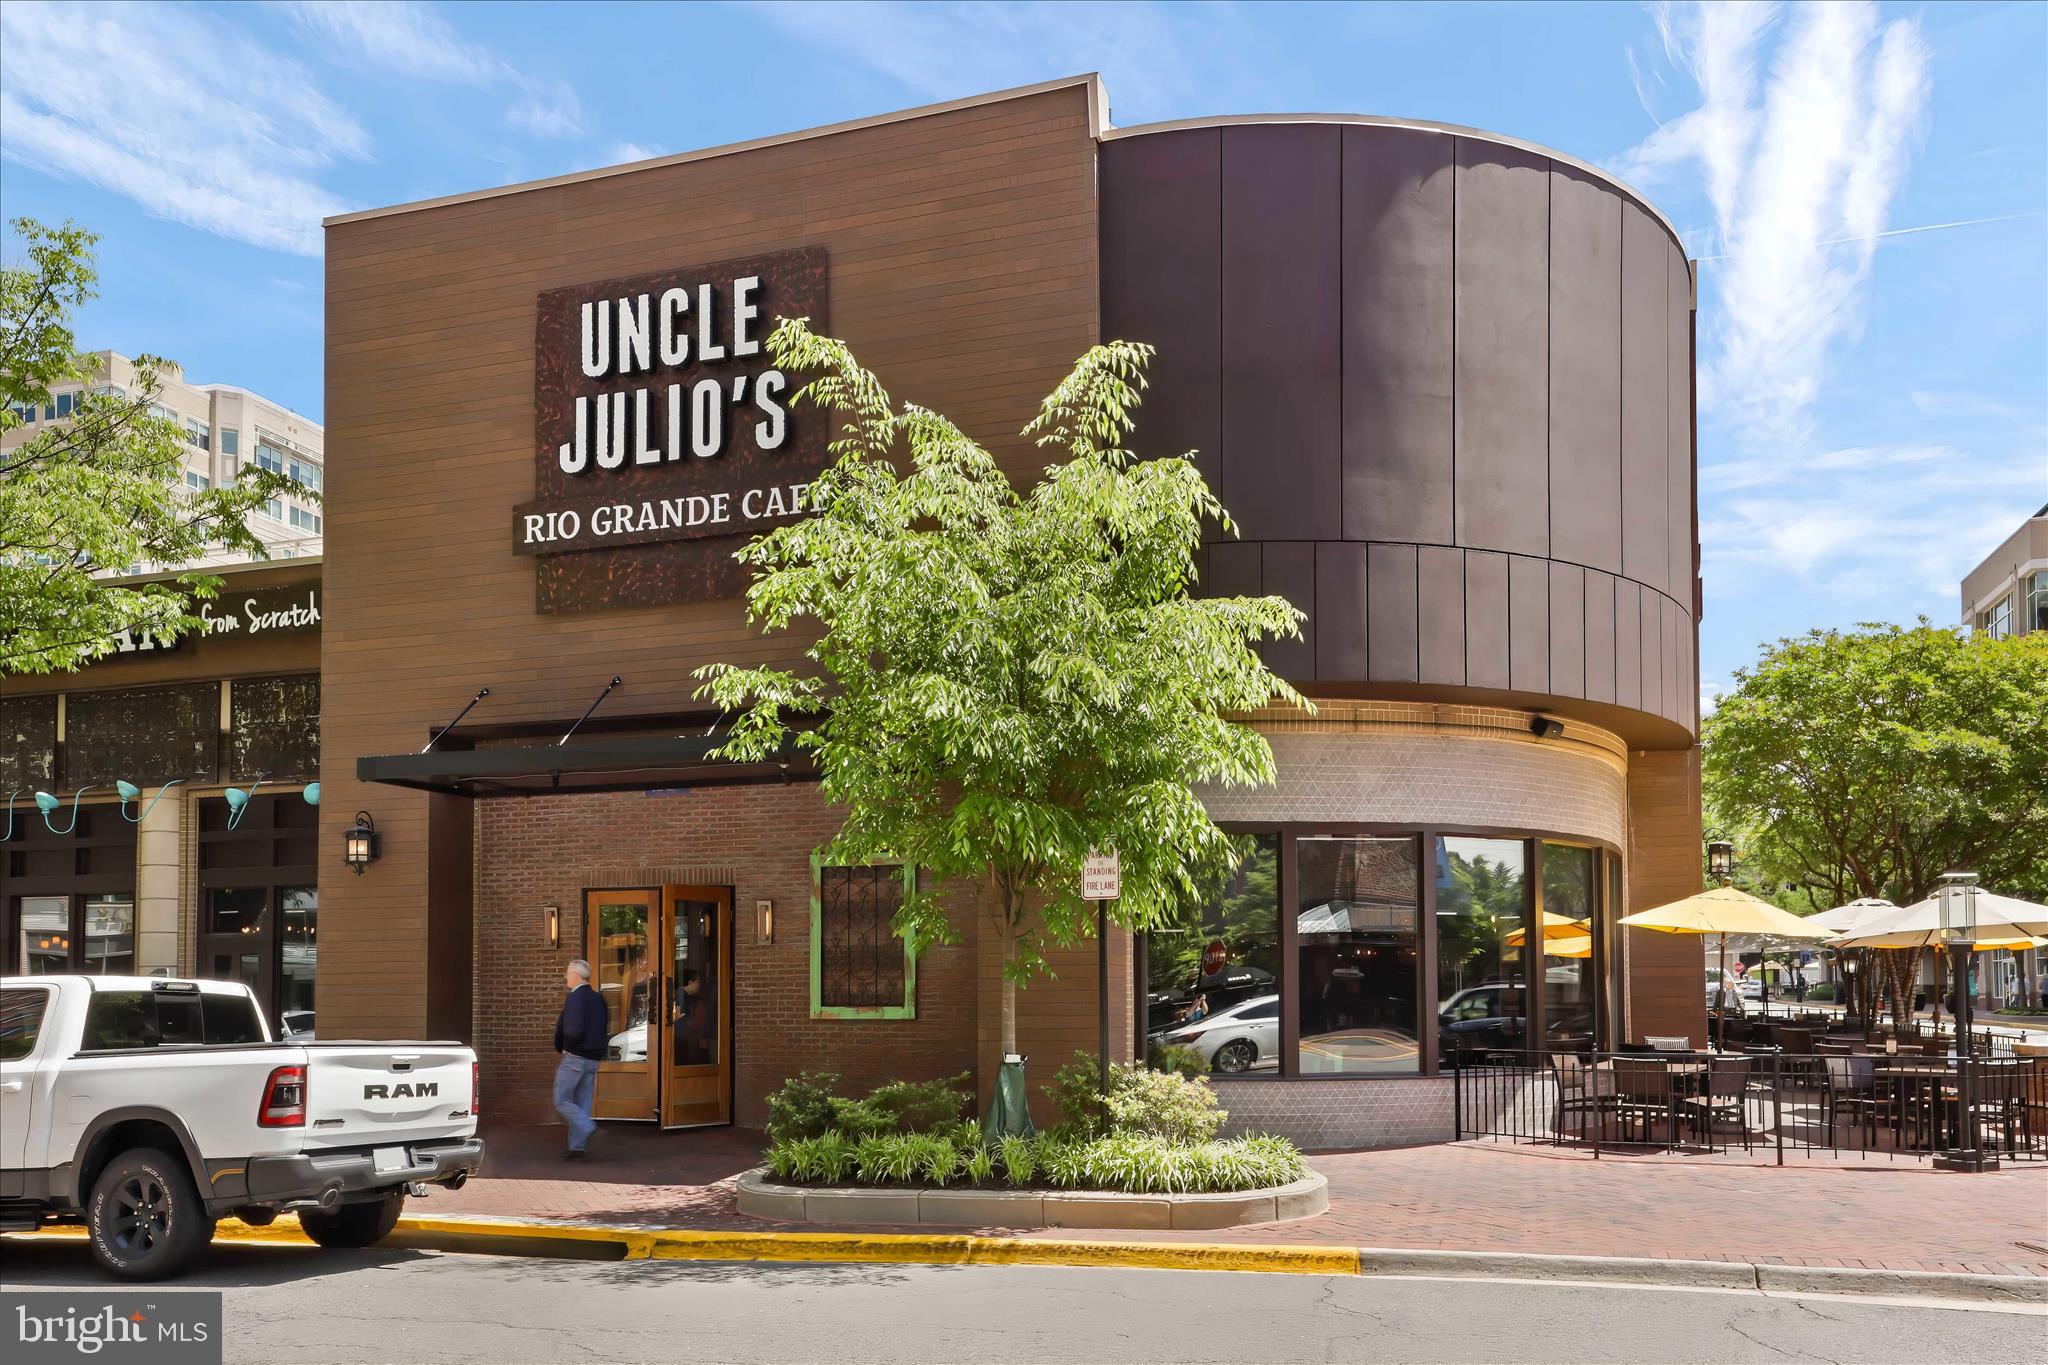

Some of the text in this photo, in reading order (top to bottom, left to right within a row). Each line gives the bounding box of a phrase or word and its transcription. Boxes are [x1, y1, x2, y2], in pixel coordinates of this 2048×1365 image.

[581, 275, 759, 377] UNCLE
[559, 369, 786, 474] JULIO'S
[523, 510, 581, 544] RIO
[590, 493, 731, 536] GRANDE
[201, 602, 240, 638] from
[244, 590, 322, 634] Scratch
[1086, 866, 1116, 876] STANDING
[1086, 881, 1116, 891] FIRE LANE
[363, 1082, 439, 1100] RAM
